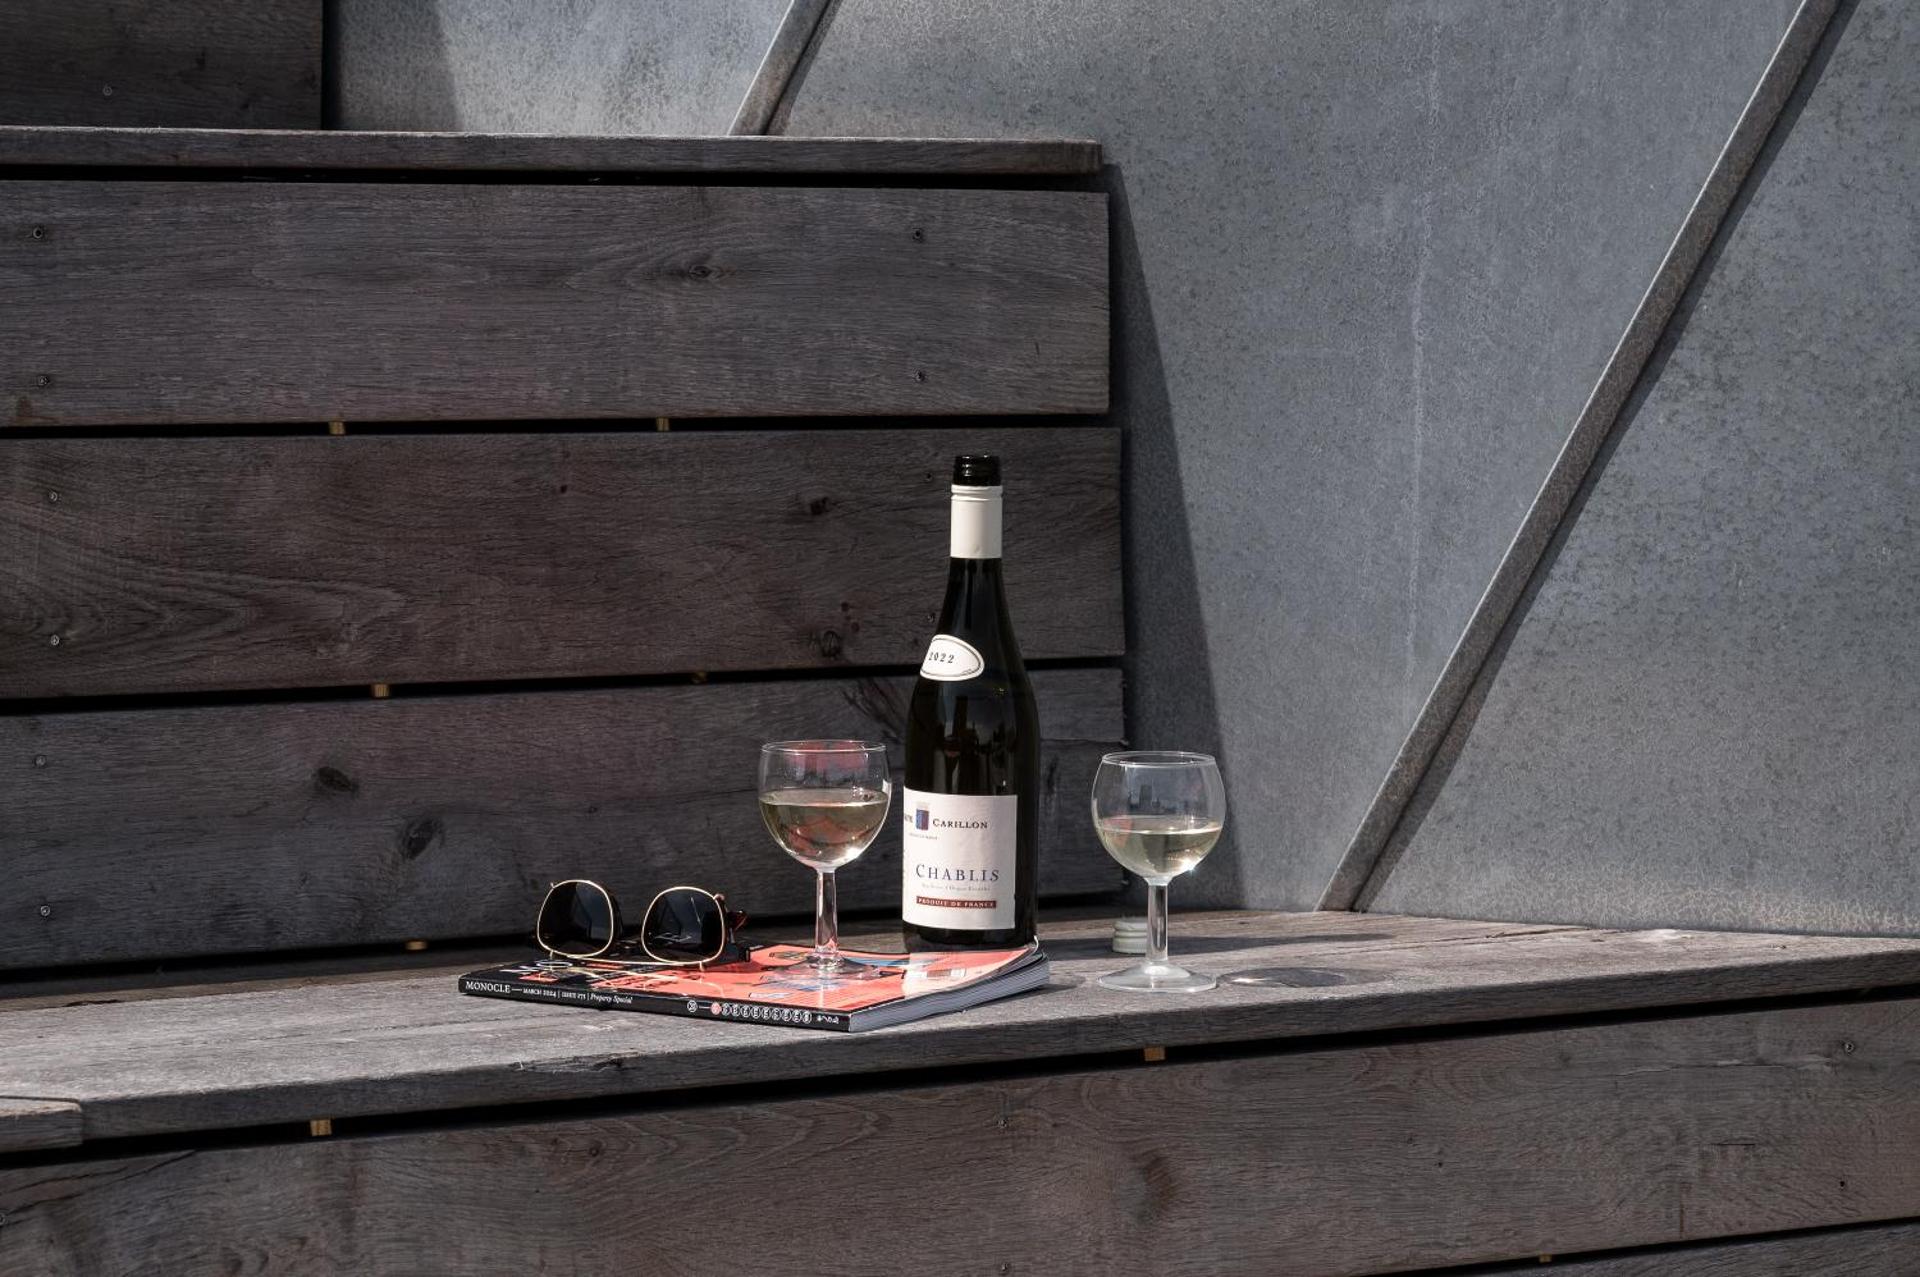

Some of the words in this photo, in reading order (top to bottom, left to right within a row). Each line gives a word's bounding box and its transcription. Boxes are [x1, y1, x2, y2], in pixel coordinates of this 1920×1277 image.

[932, 818, 989, 829] CARILLON
[916, 864, 1000, 881] CHABLIS
[465, 980, 511, 994] MONOCLE
[523, 987, 541, 995] MARCH
